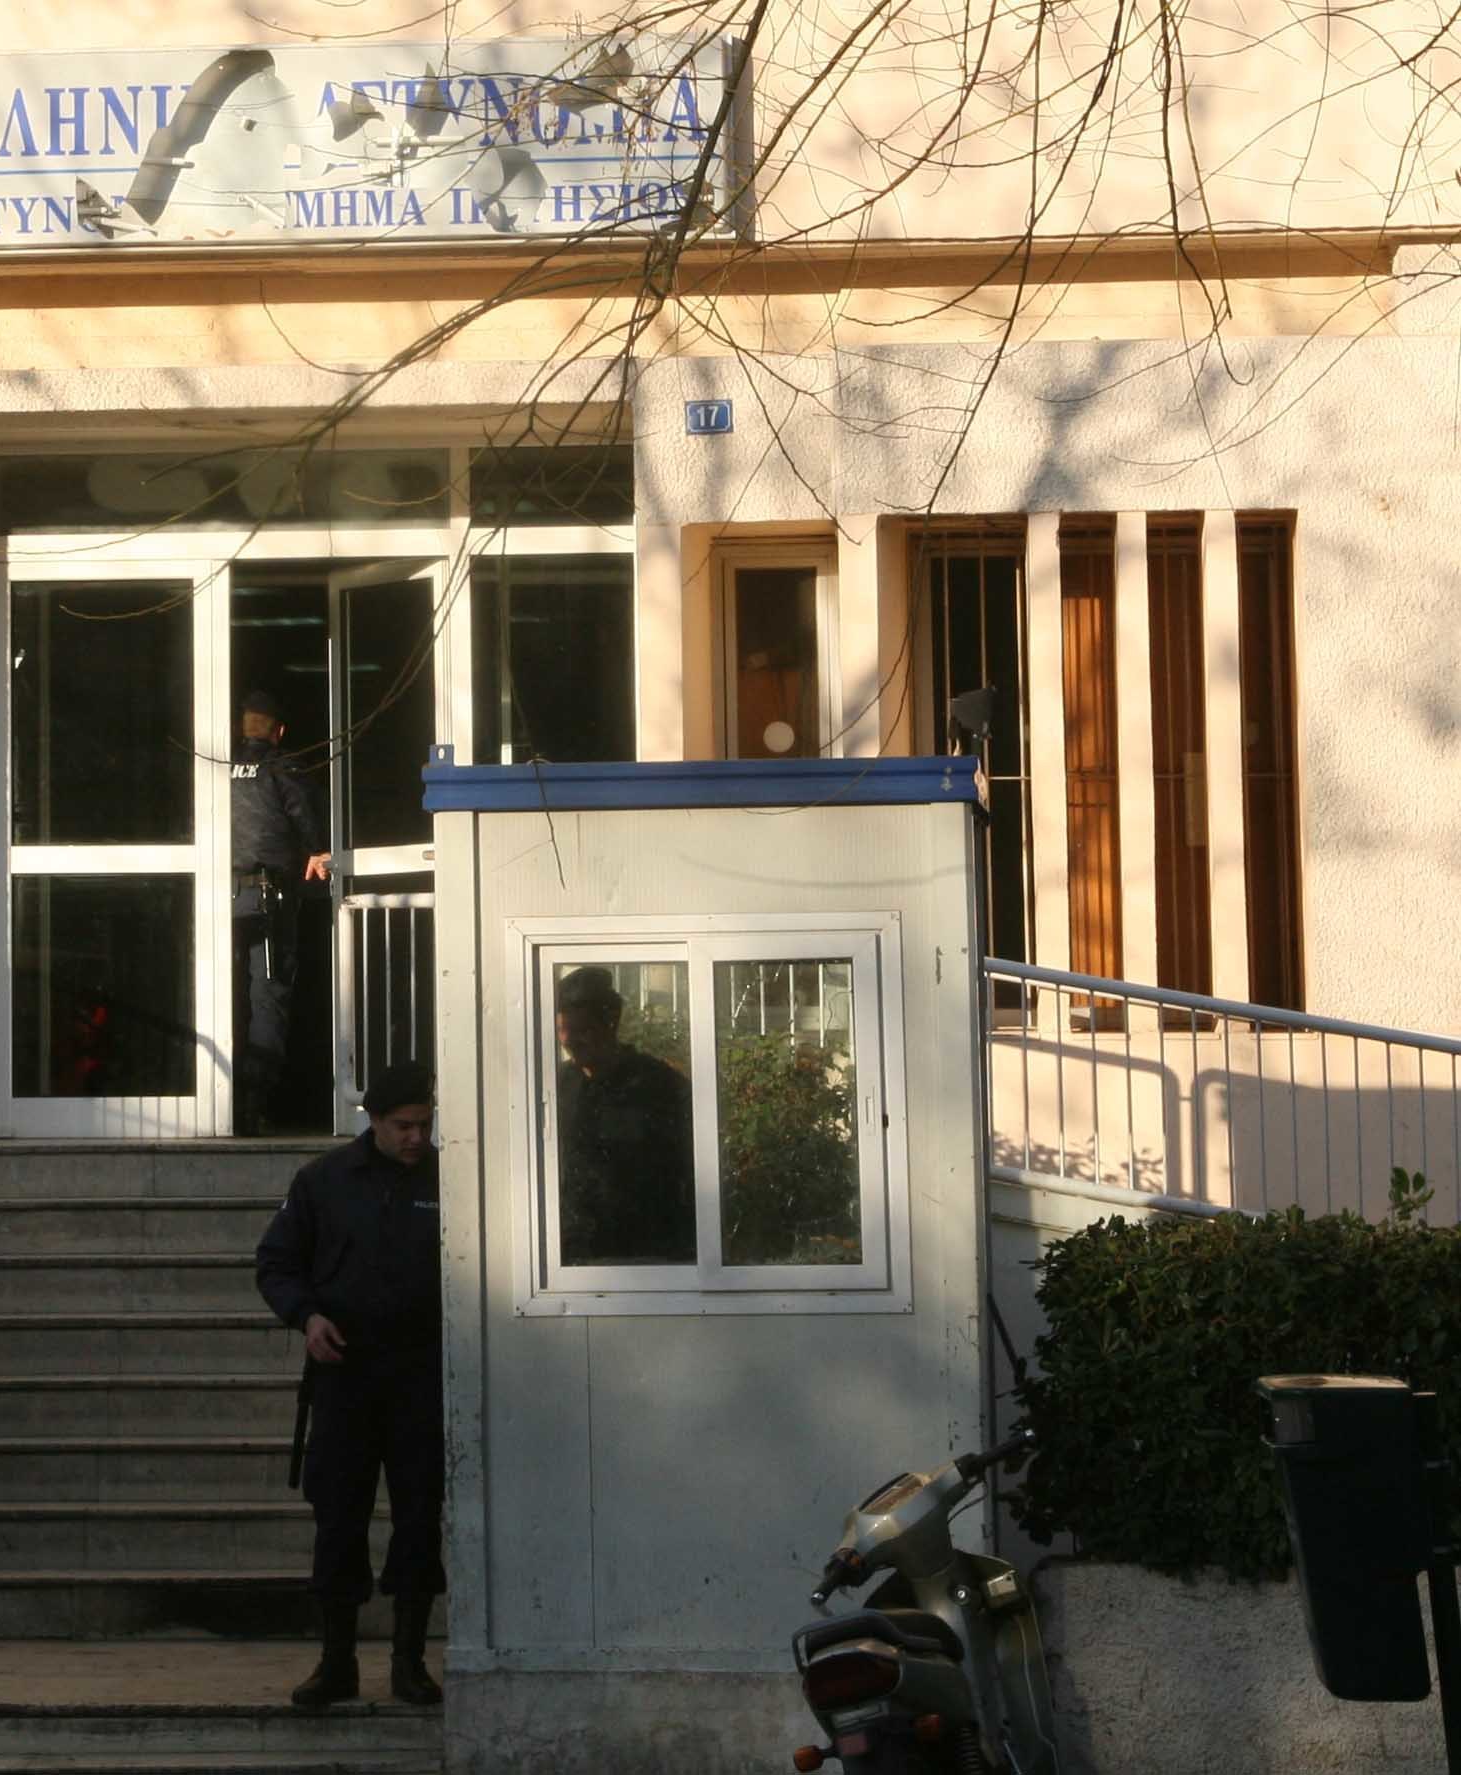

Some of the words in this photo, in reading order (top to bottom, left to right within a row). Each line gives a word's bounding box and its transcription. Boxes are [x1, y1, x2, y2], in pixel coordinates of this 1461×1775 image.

[284, 188, 427, 229] ΜΗΜΑ
[697, 405, 719, 427] 17
[231, 764, 260, 778] ICE
